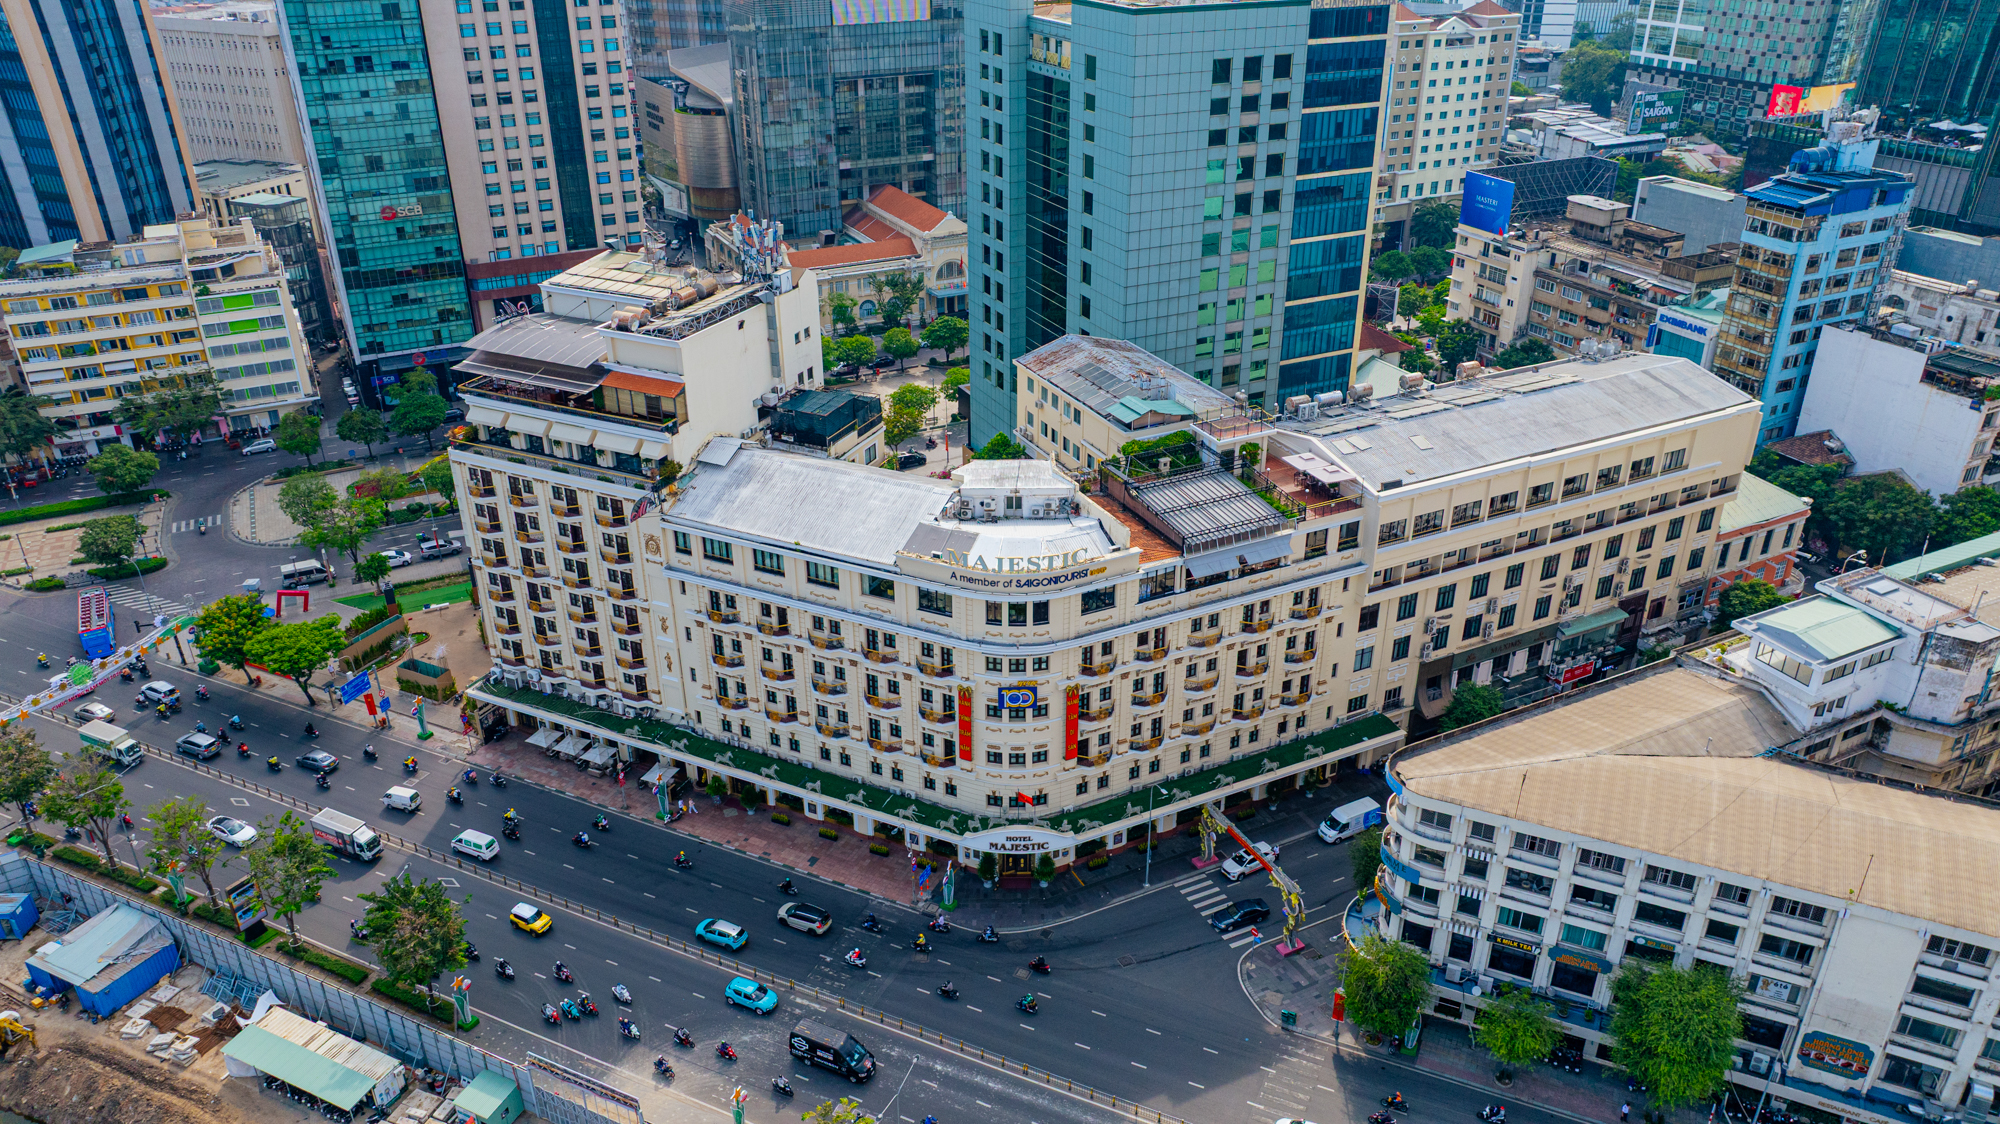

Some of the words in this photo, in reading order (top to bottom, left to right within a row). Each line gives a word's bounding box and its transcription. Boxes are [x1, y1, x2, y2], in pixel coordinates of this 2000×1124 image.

[397, 204, 422, 217] SCB
[1659, 313, 1708, 337] EXIMBANK
[946, 547, 1088, 574] MAJESTIC
[950, 571, 958, 580] A
[959, 574, 1000, 588] member
[1002, 578, 1013, 588] of
[1015, 568, 1089, 588] SAIGONTOURIST
[1000, 689, 1035, 708] 100
[960, 743, 970, 752] NĂM
[989, 842, 1049, 852] MAJESTIC
[1502, 939, 1518, 947] MILK
[1519, 943, 1532, 951] TEA
[1804, 1042, 1837, 1055] DRAGON
[1838, 1052, 1870, 1065] PALACE
[1842, 1047, 1864, 1058] LONG
[1818, 1100, 1861, 1118] RESTAURANT
